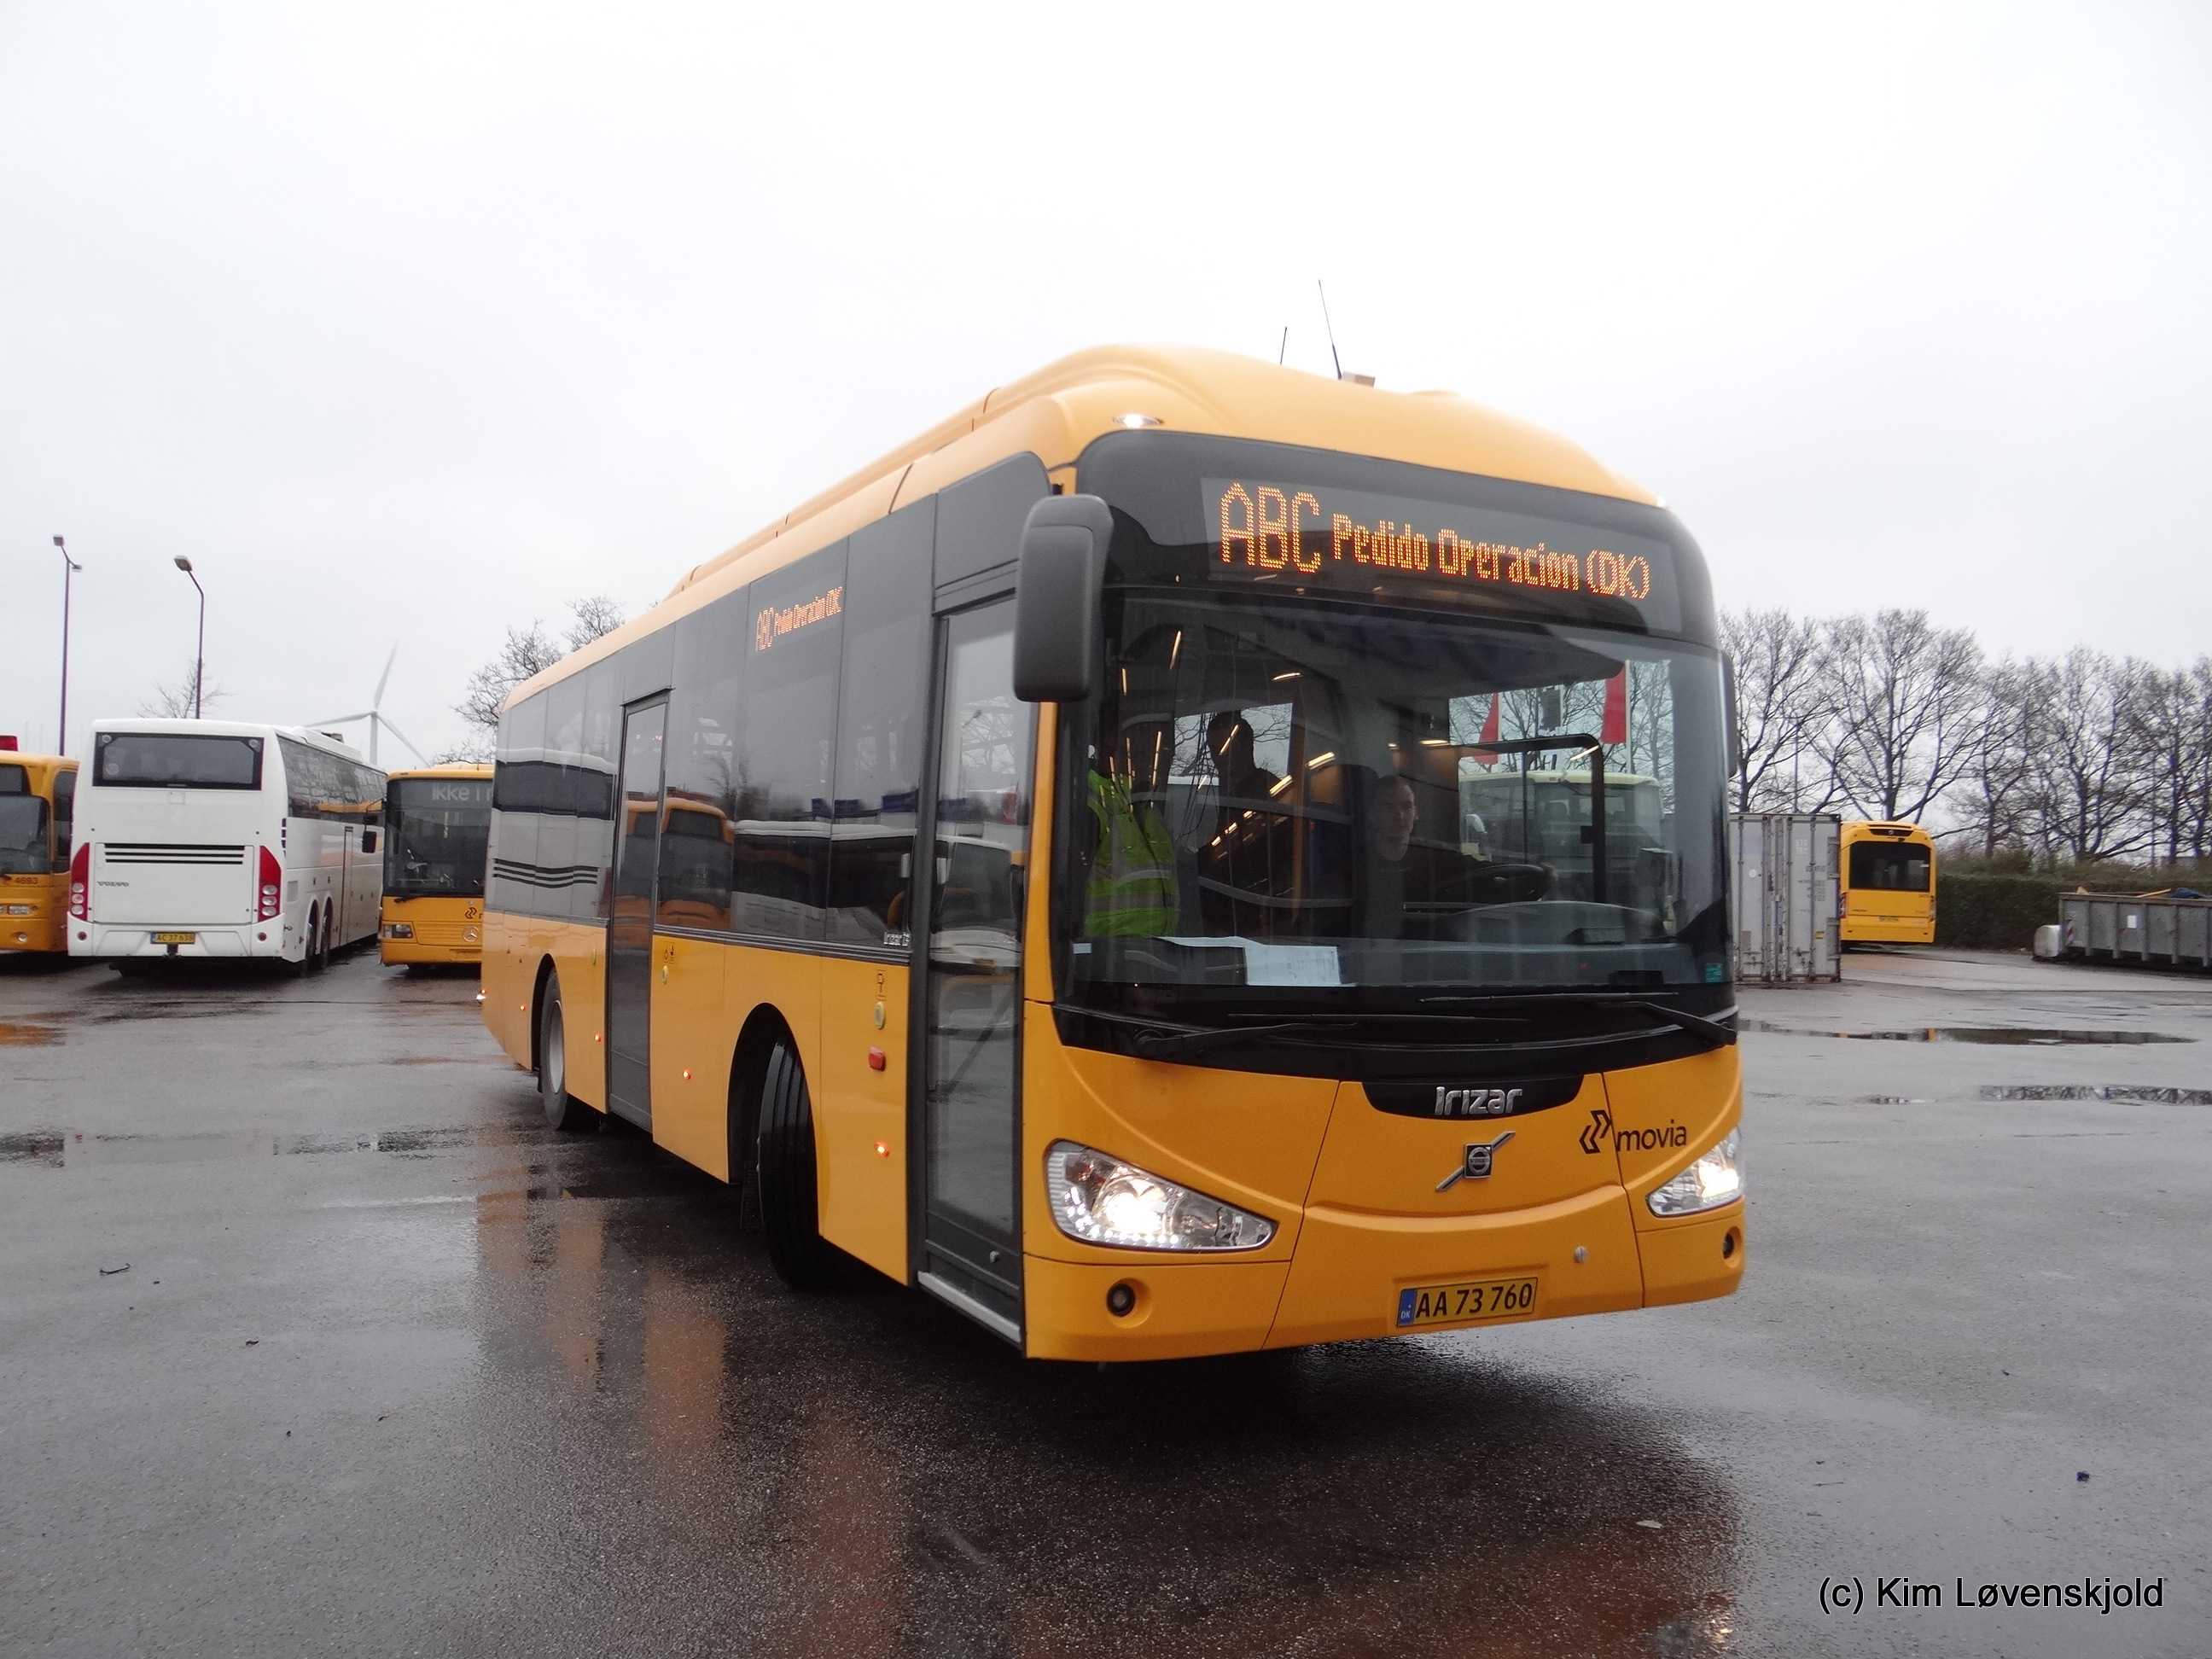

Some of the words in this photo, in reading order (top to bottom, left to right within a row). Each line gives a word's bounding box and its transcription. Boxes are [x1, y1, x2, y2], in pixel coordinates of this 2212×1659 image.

[1220, 482, 1321, 573] ABC
[1333, 513, 1429, 572] Pedido
[1438, 528, 1579, 591] Operacion
[1586, 550, 1650, 600] (DK)
[432, 783, 470, 801] Ikke
[1435, 1086, 1523, 1115] Irizar
[1615, 1119, 1688, 1152] movia
[1400, 1311, 1411, 1320] DK
[1415, 1291, 1448, 1319] AA
[1455, 1288, 1484, 1316] 73
[1490, 1283, 1533, 1312] 760
